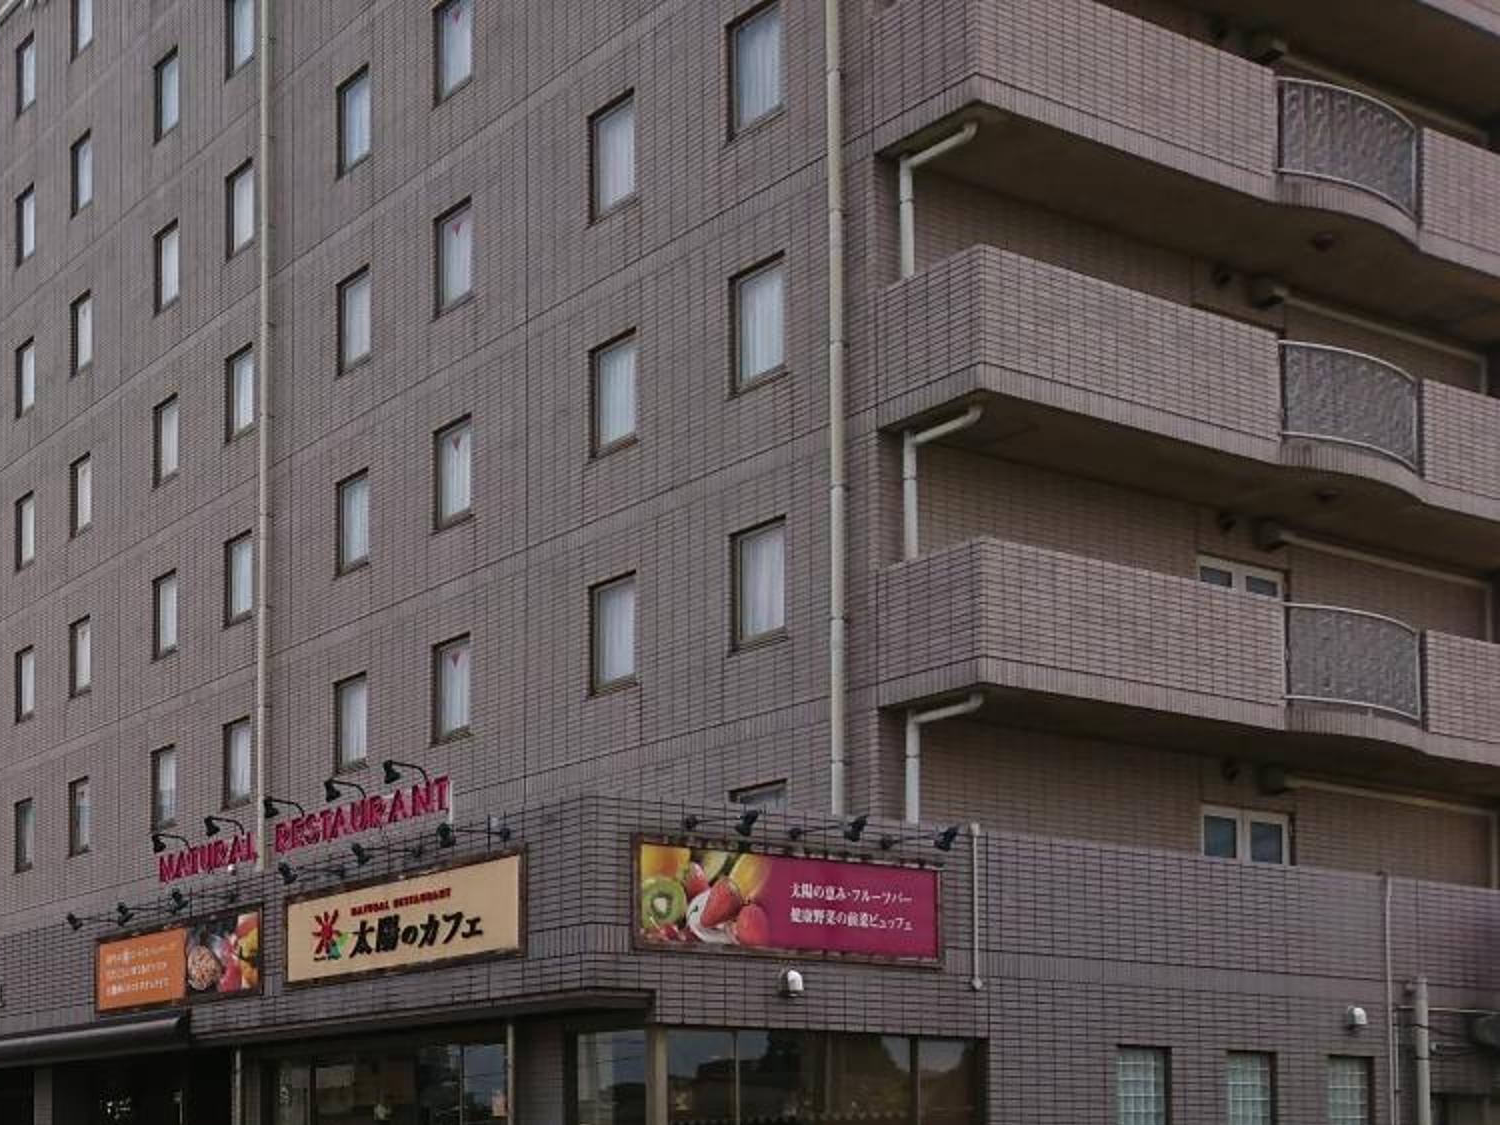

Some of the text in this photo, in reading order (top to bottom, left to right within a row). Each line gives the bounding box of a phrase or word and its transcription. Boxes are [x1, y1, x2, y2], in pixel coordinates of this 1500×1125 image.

[158, 775, 449, 882] NATURAL RESTAURANT
[350, 887, 453, 917] NATURAL RESTAURANT
[350, 911, 484, 958] 太陽のカフェ
